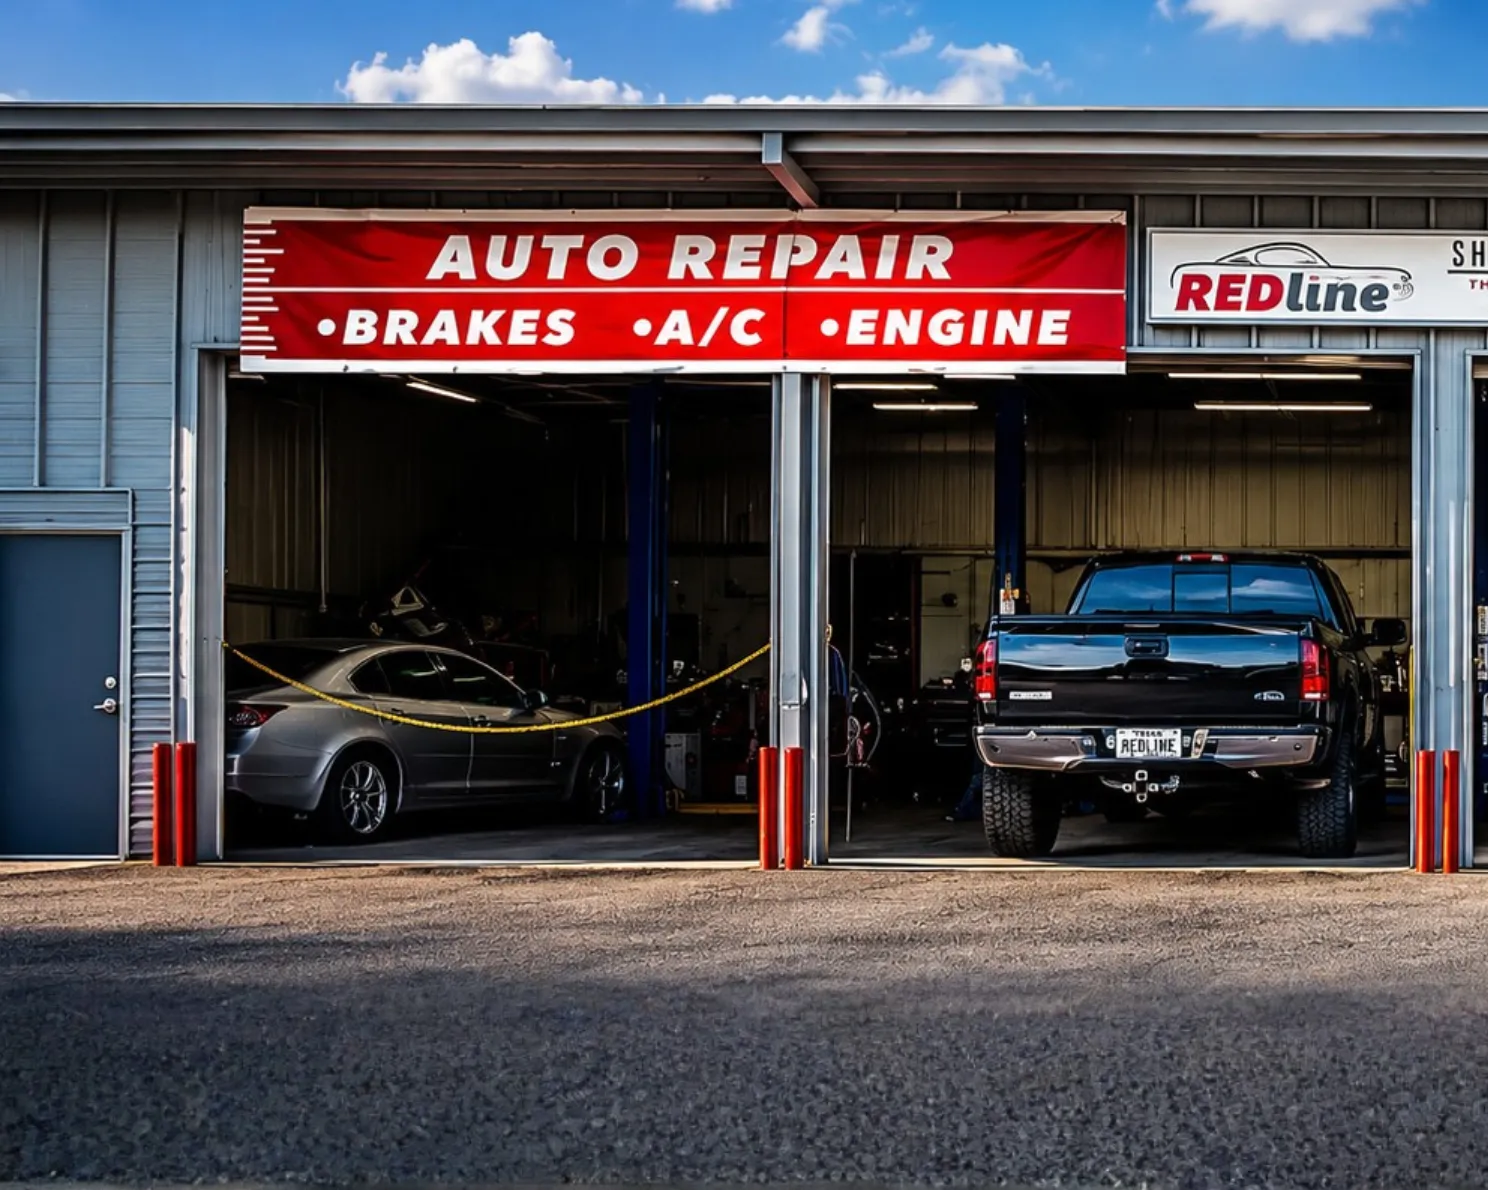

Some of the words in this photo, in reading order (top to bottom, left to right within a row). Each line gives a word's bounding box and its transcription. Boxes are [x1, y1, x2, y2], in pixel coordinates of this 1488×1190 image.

[426, 235, 638, 280] AUTO
[668, 235, 953, 280] REPAIR
[1174, 272, 1389, 312] REDline
